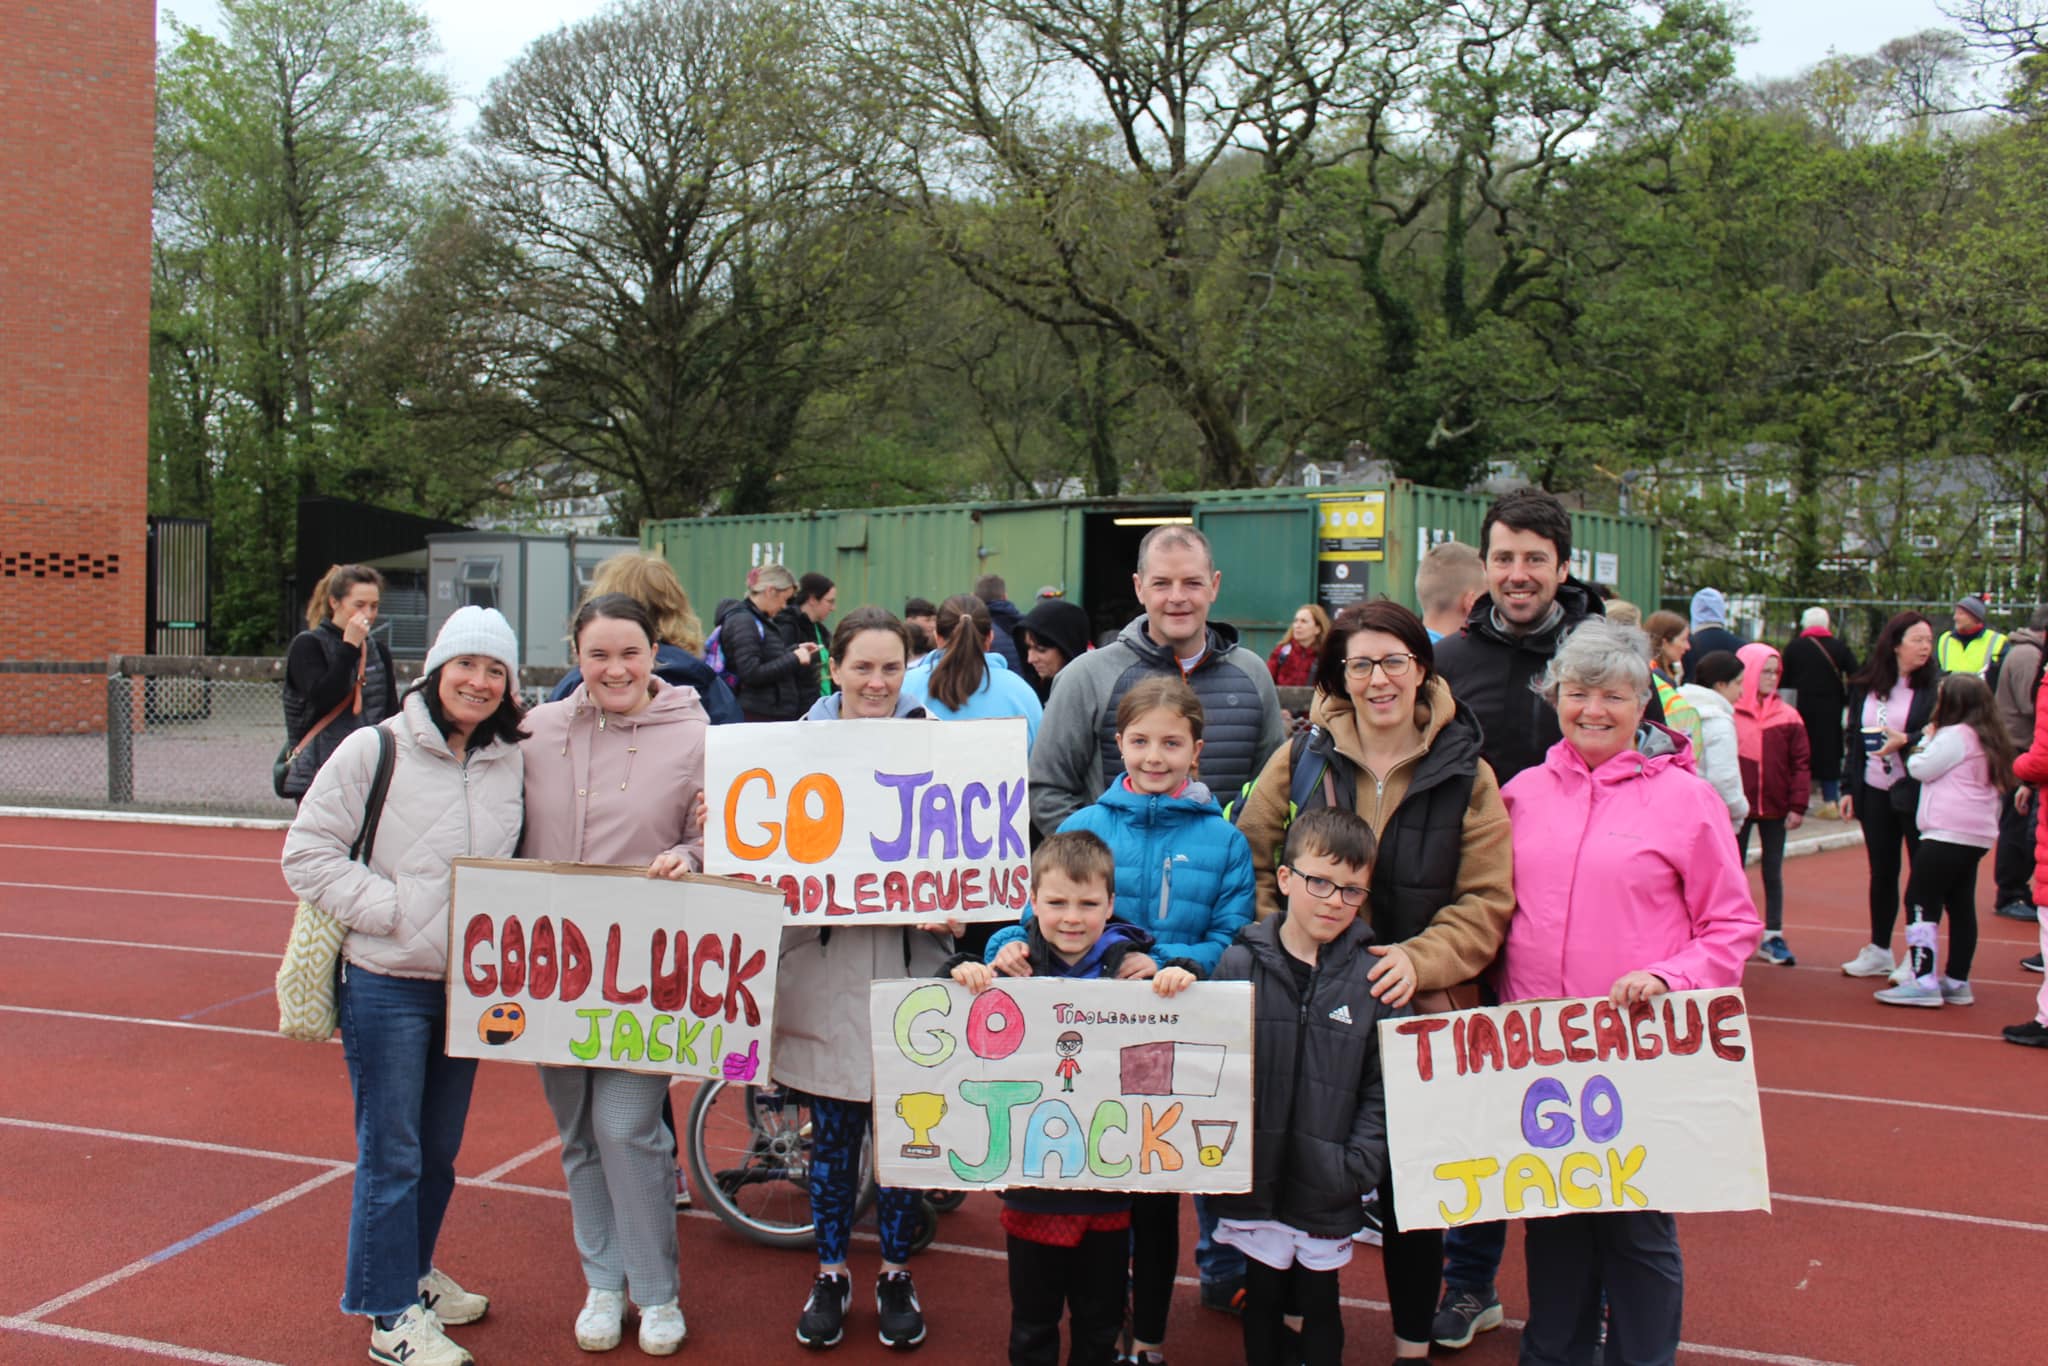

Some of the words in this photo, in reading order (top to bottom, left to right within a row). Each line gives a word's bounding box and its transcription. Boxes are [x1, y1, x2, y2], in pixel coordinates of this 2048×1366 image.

[724, 768, 845, 864] GO
[869, 770, 1026, 862] JACK
[463, 913, 592, 1001] GOOD
[602, 922, 767, 1027] LUCK
[569, 1008, 724, 1075] JACK!
[893, 984, 1025, 1067] GO
[948, 1080, 1183, 1183] JACK
[1521, 1074, 1623, 1149] GO
[1434, 1145, 1649, 1225] JACK
